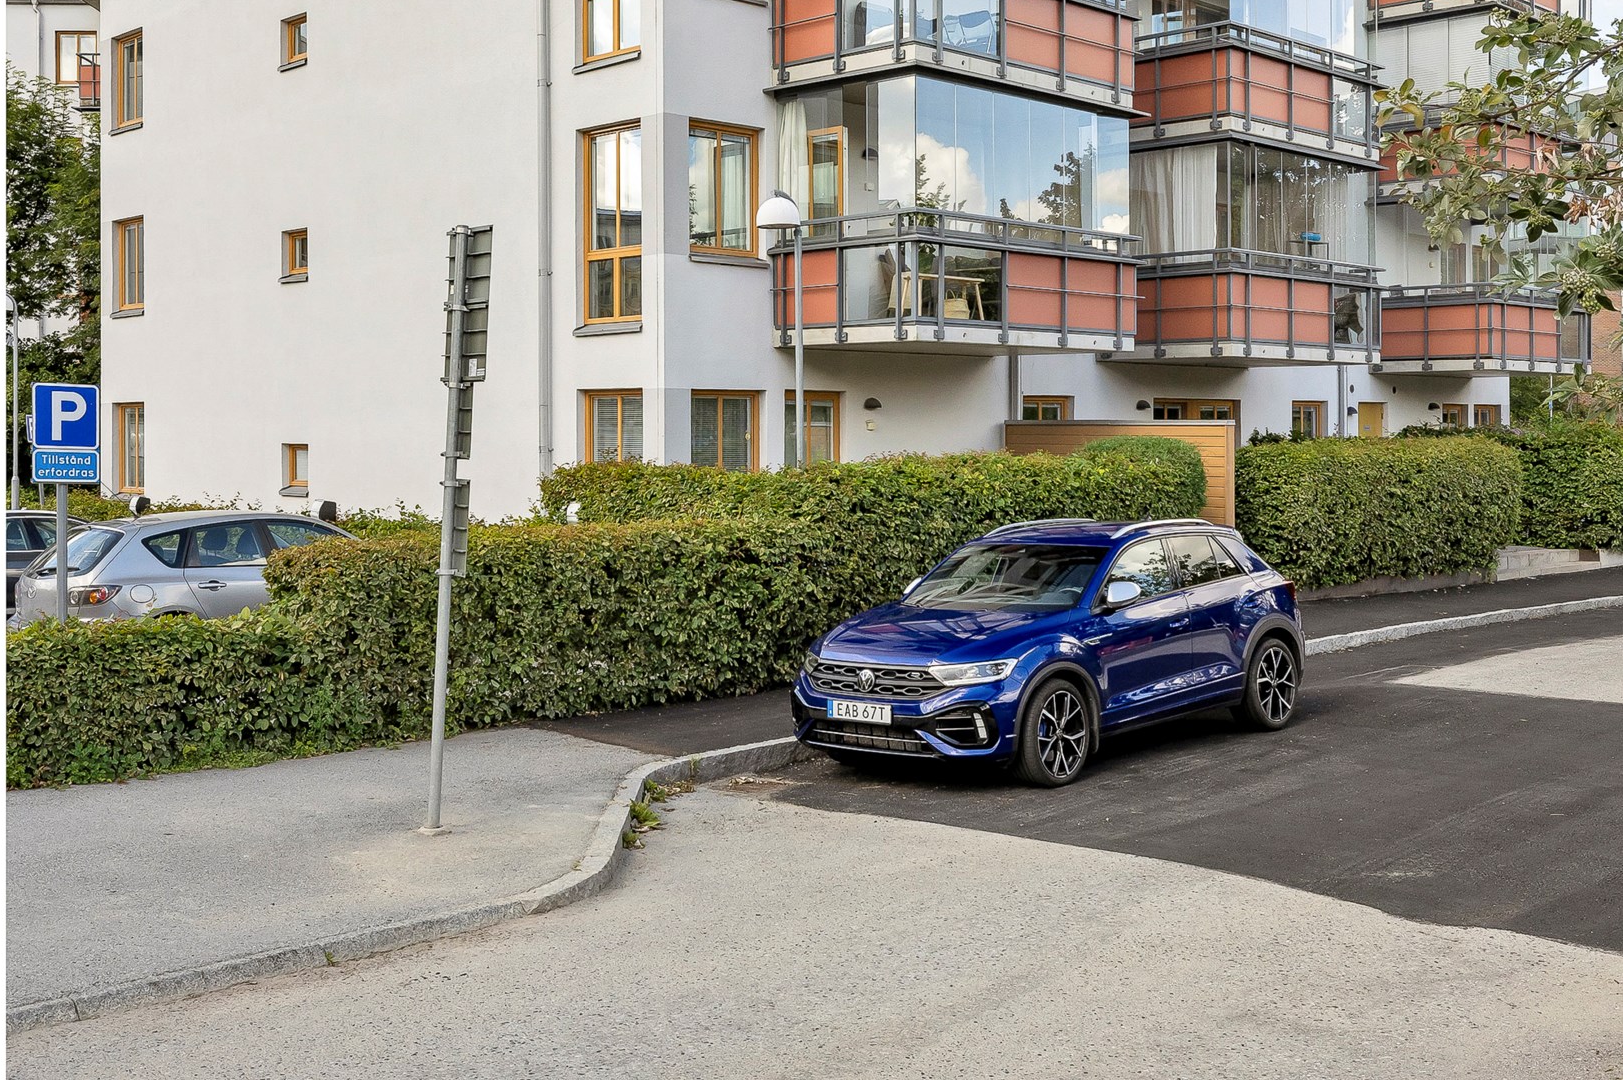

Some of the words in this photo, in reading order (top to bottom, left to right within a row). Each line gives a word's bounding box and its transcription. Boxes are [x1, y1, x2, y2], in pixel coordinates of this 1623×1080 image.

[51, 390, 87, 441] P
[41, 454, 91, 465] Tillstånd
[38, 467, 95, 477] erfordras
[837, 703, 859, 718] EAB
[862, 705, 886, 721] 67T
